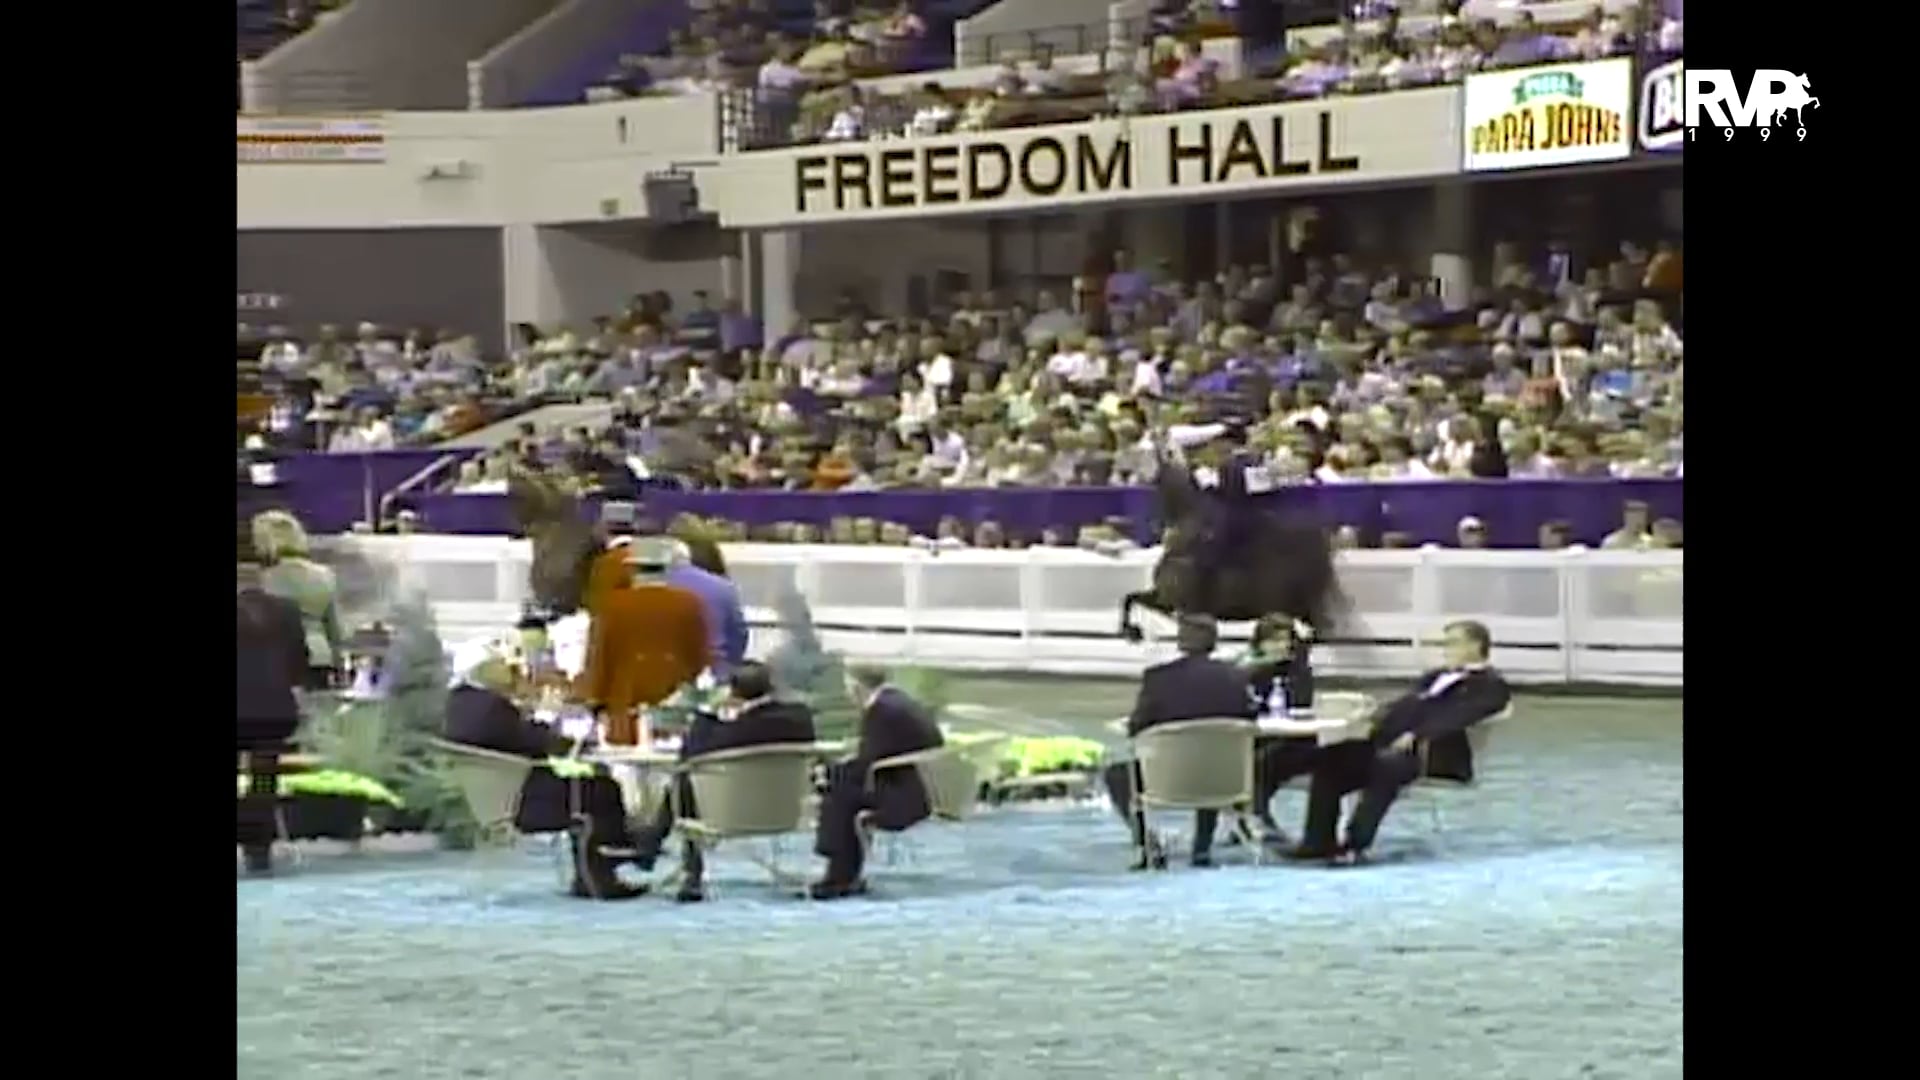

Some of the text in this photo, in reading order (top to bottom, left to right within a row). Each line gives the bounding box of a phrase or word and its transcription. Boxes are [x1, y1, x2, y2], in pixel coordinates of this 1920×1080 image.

[797, 111, 1359, 212] FREEDOM HALL
[1472, 108, 1535, 153] PAPA
